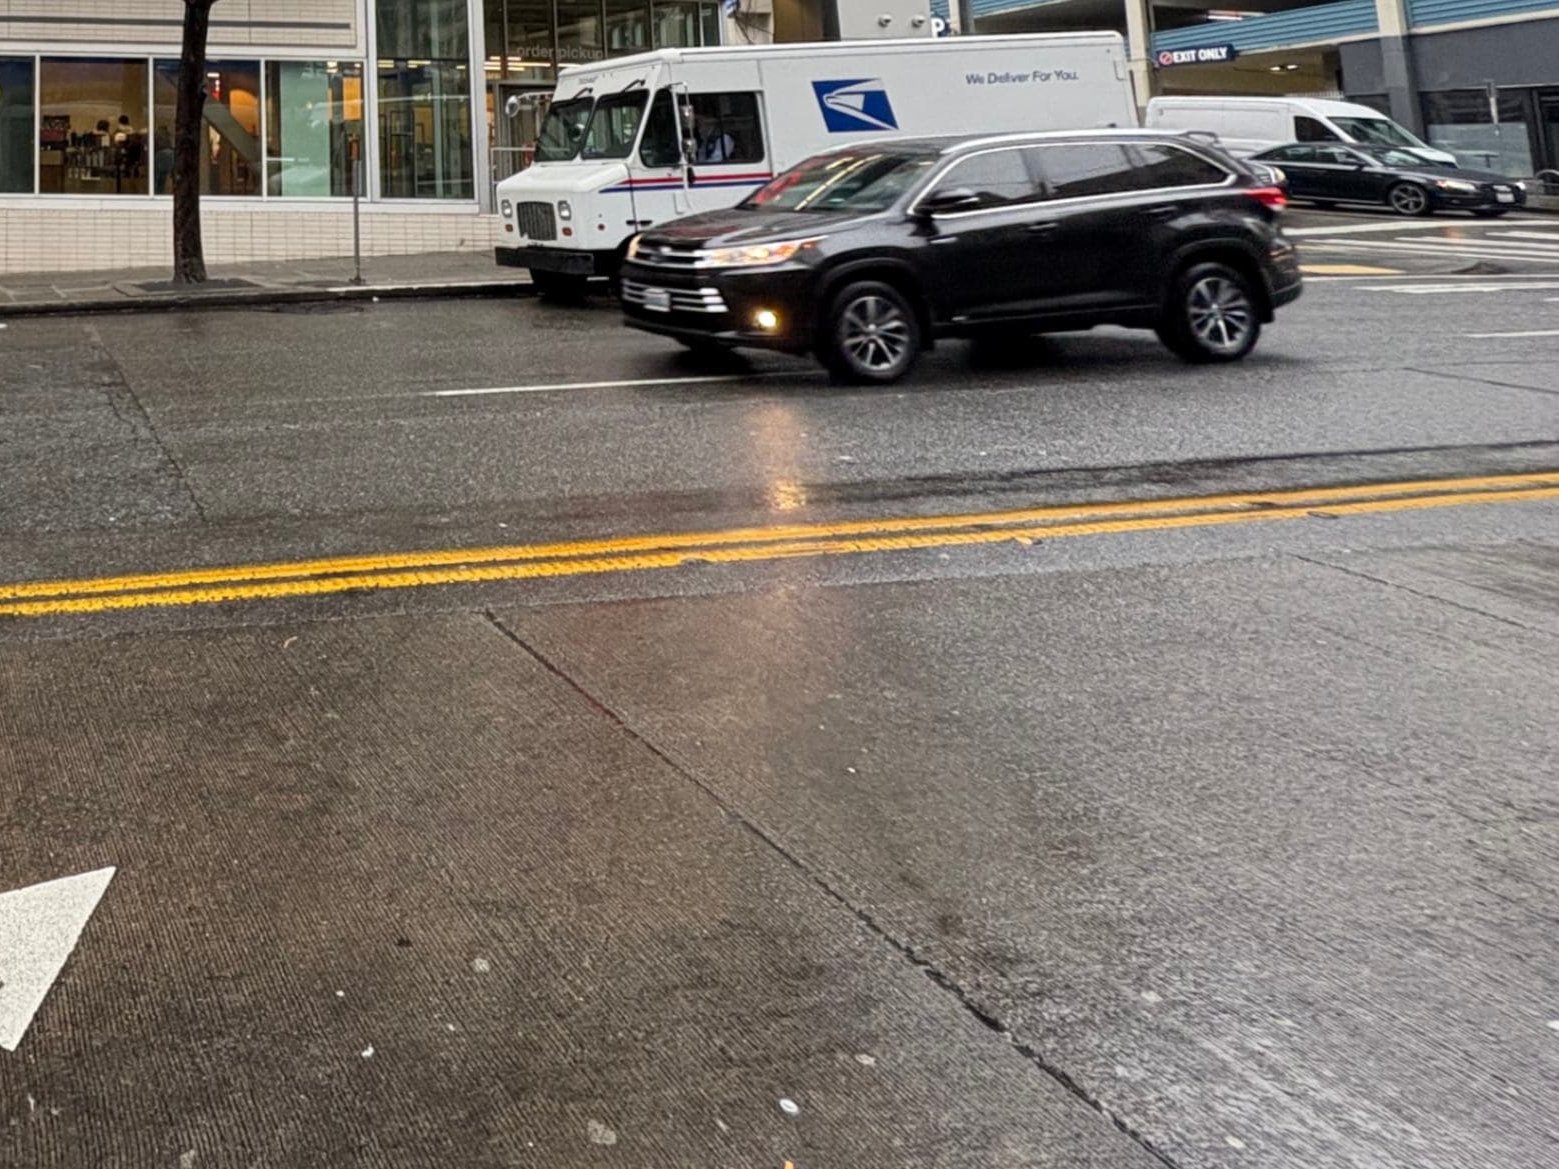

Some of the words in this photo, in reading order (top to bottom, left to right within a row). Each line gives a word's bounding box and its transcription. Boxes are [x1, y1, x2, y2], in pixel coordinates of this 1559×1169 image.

[517, 44, 553, 57] order
[1173, 50, 1196, 63] EXIT
[1198, 47, 1227, 61] ONLY
[966, 74, 984, 84] We
[987, 72, 1029, 84] Deliver
[1032, 70, 1052, 82] For
